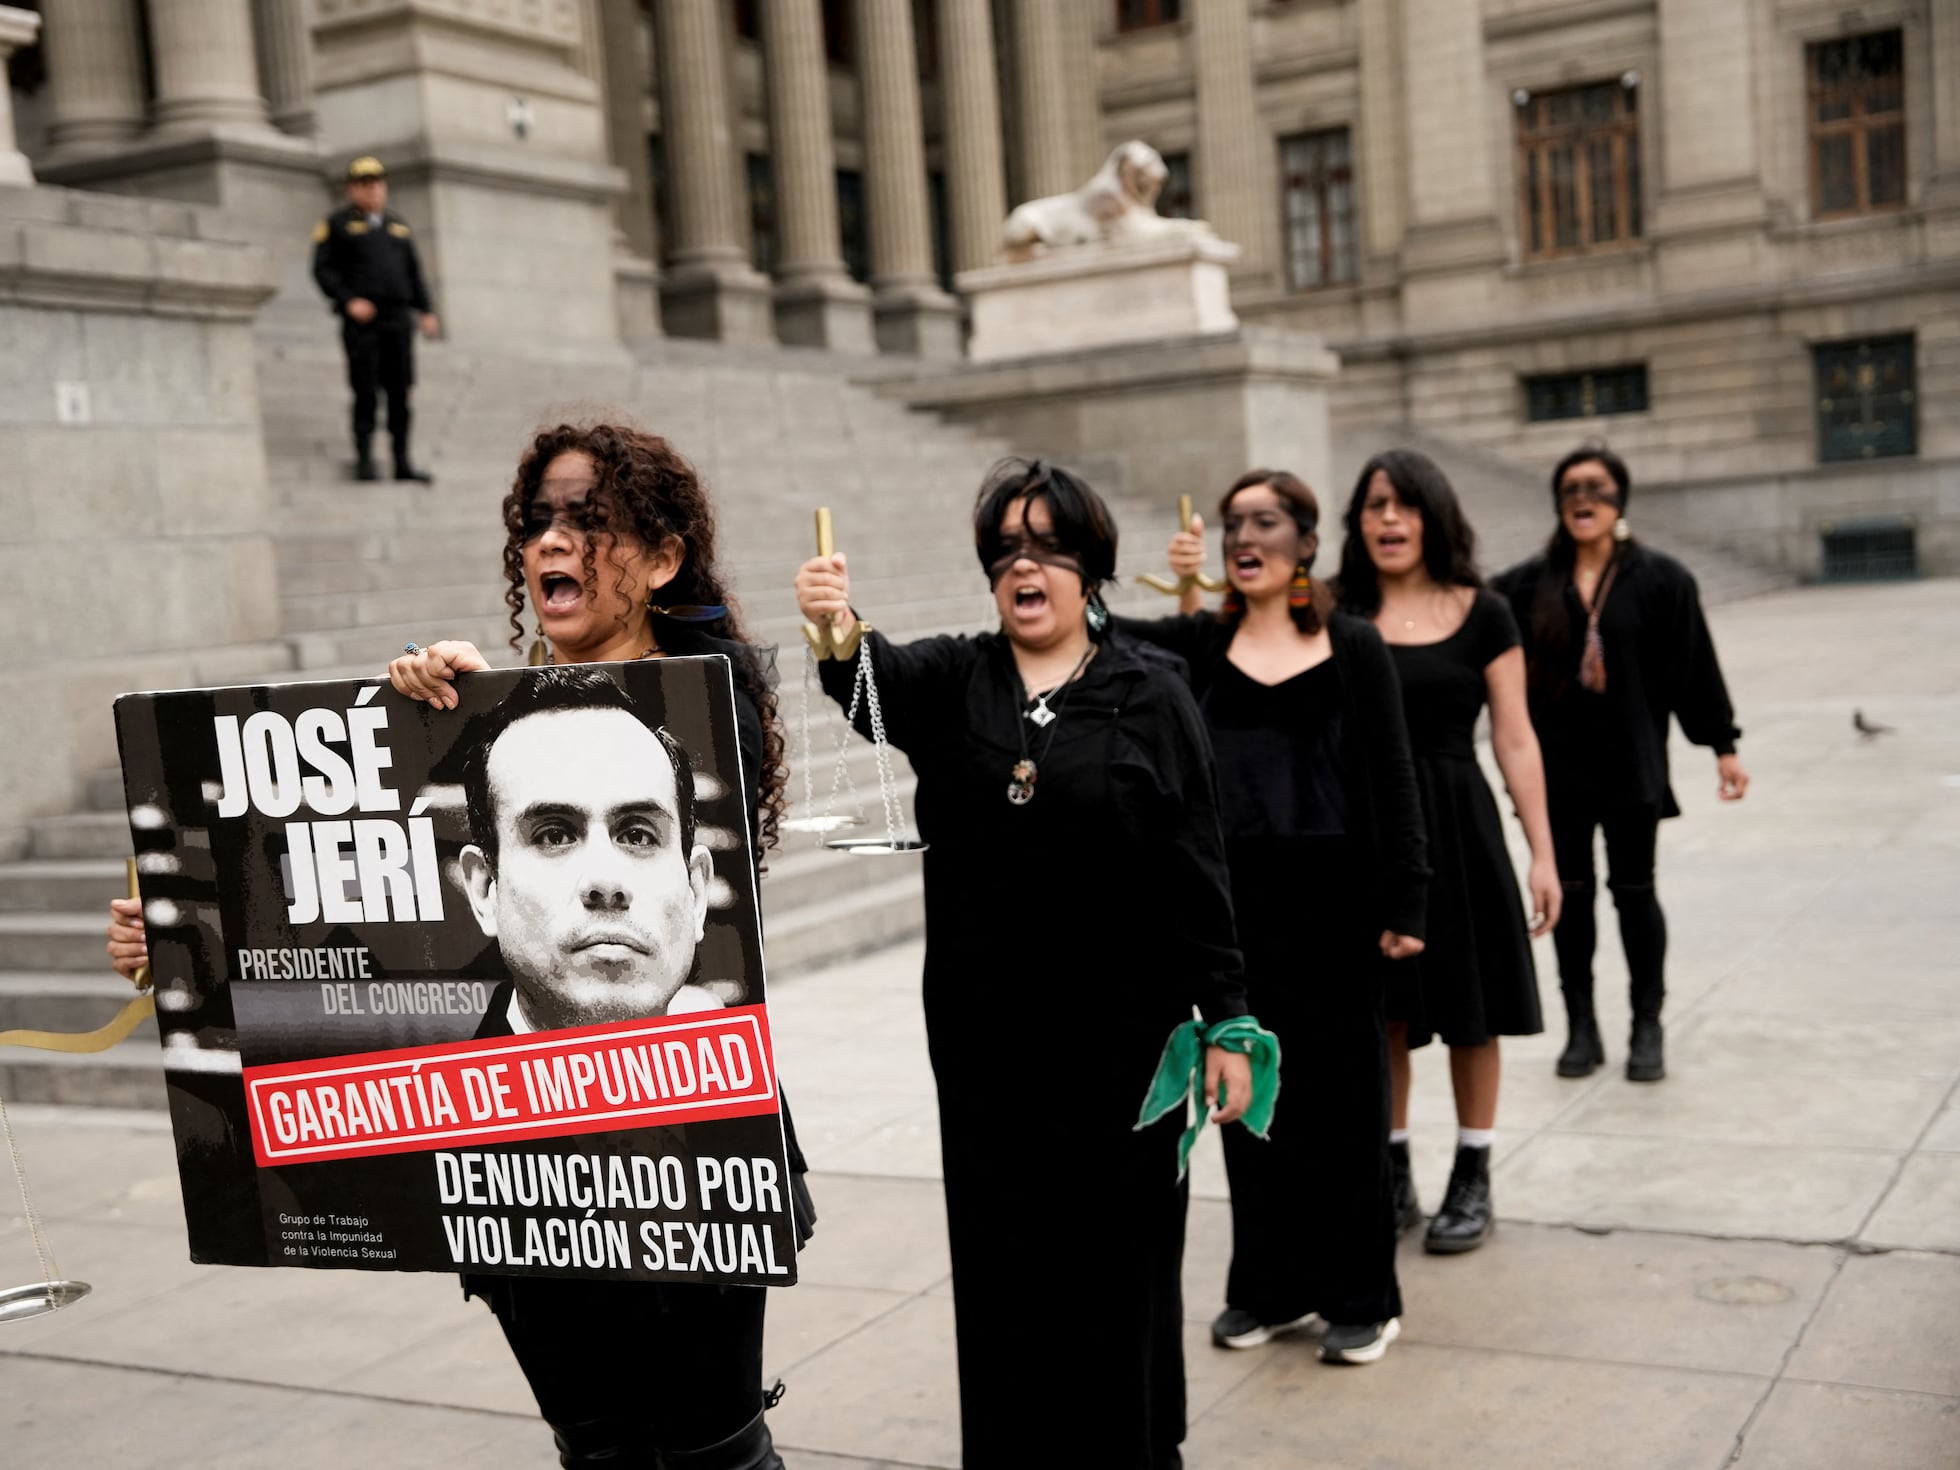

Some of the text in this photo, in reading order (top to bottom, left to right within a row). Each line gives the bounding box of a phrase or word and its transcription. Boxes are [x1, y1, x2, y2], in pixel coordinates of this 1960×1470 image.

[214, 686, 400, 818] JOSÉ
[285, 797, 445, 924] JERÍ
[238, 947, 372, 980] PRESIDENTE
[321, 982, 488, 1015] DEL CONGRESO
[269, 1033, 755, 1145] GARANTÍA DE IMPUNIDAD
[435, 1152, 782, 1213] DENUNCIADO POR
[279, 1213, 369, 1228] Grupo de Trabajo
[281, 1230, 383, 1243] contra la Impunidad
[442, 1209, 788, 1275] VIOLACIÓN SEXUAL
[284, 1245, 397, 1259] de la Violencia Sexual
